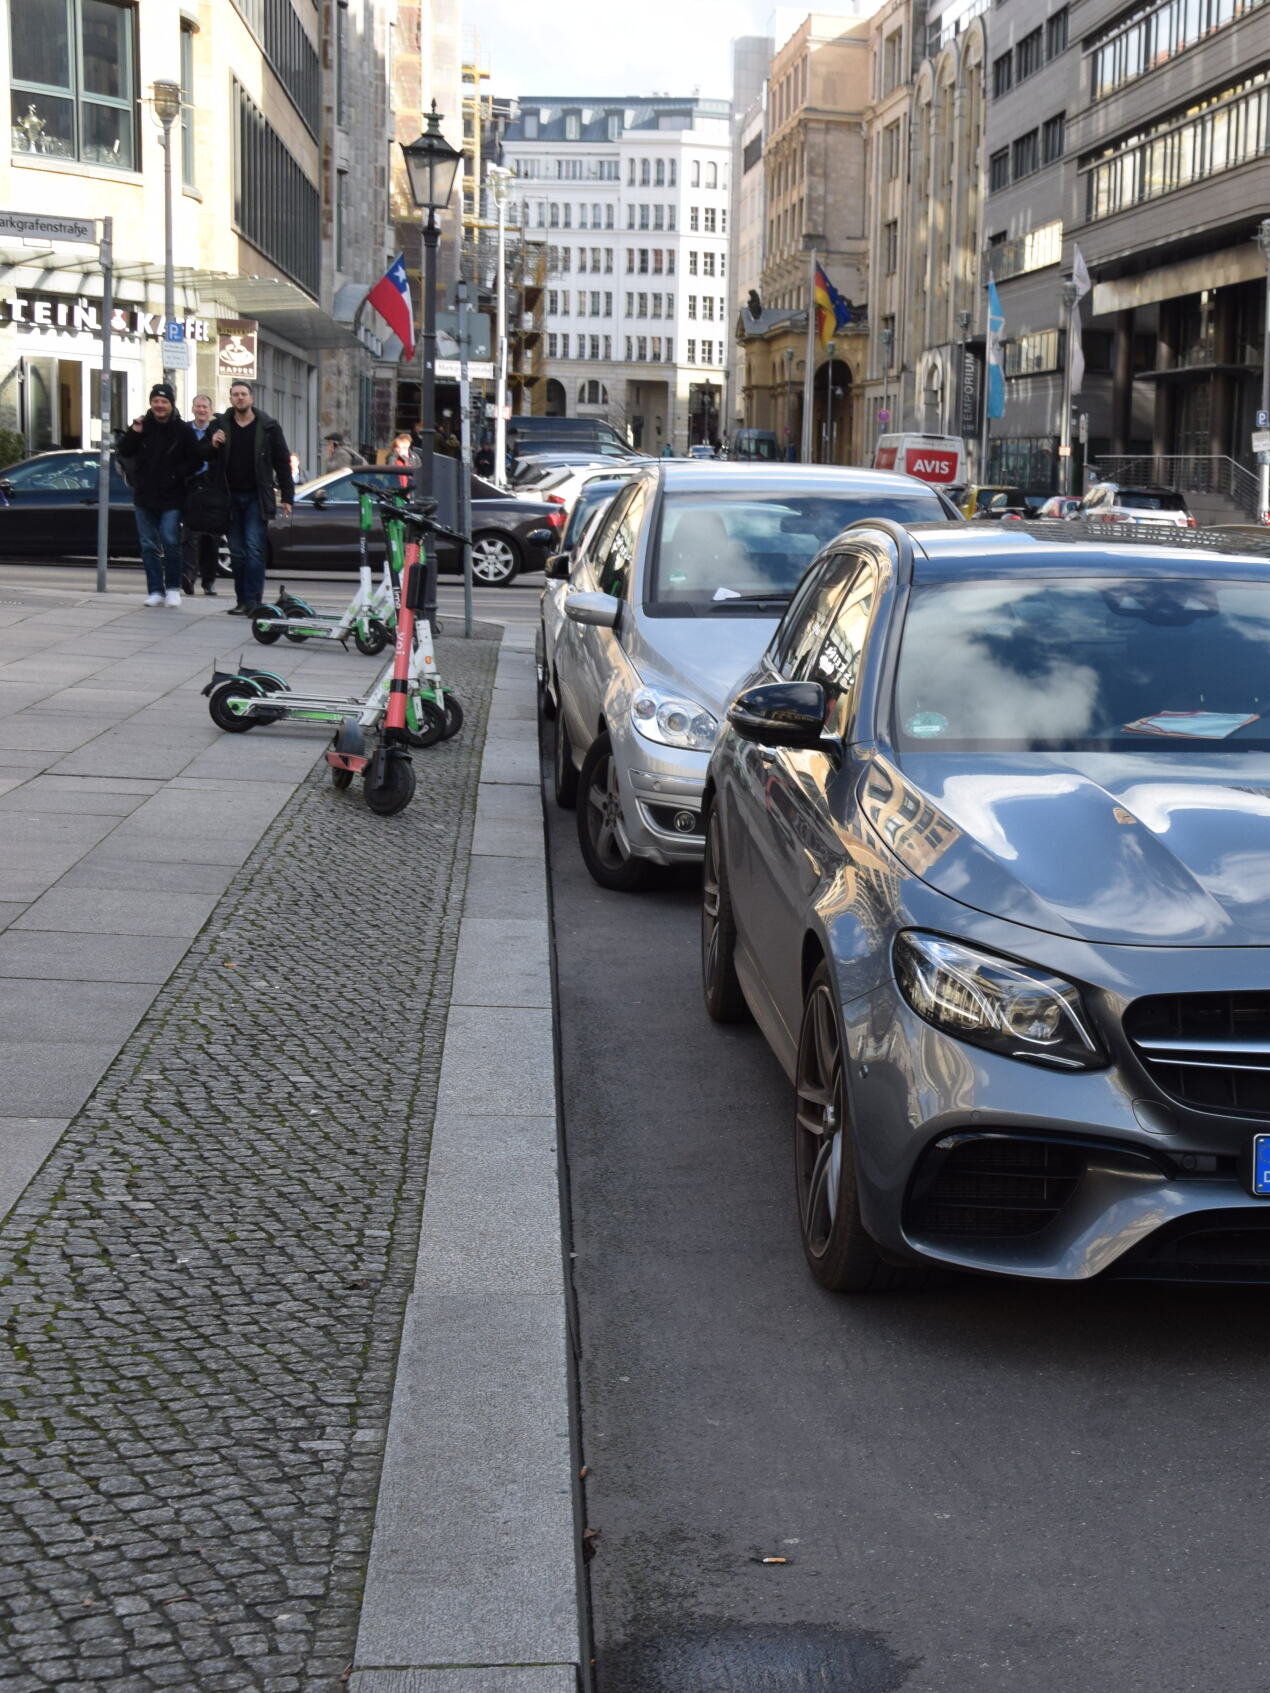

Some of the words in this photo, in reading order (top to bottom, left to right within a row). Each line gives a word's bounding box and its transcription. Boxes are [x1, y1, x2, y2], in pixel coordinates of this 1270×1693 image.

[0, 298, 101, 330] TEIN
[963, 352, 976, 421] EMPORIUM
[912, 458, 950, 475] AVIS
